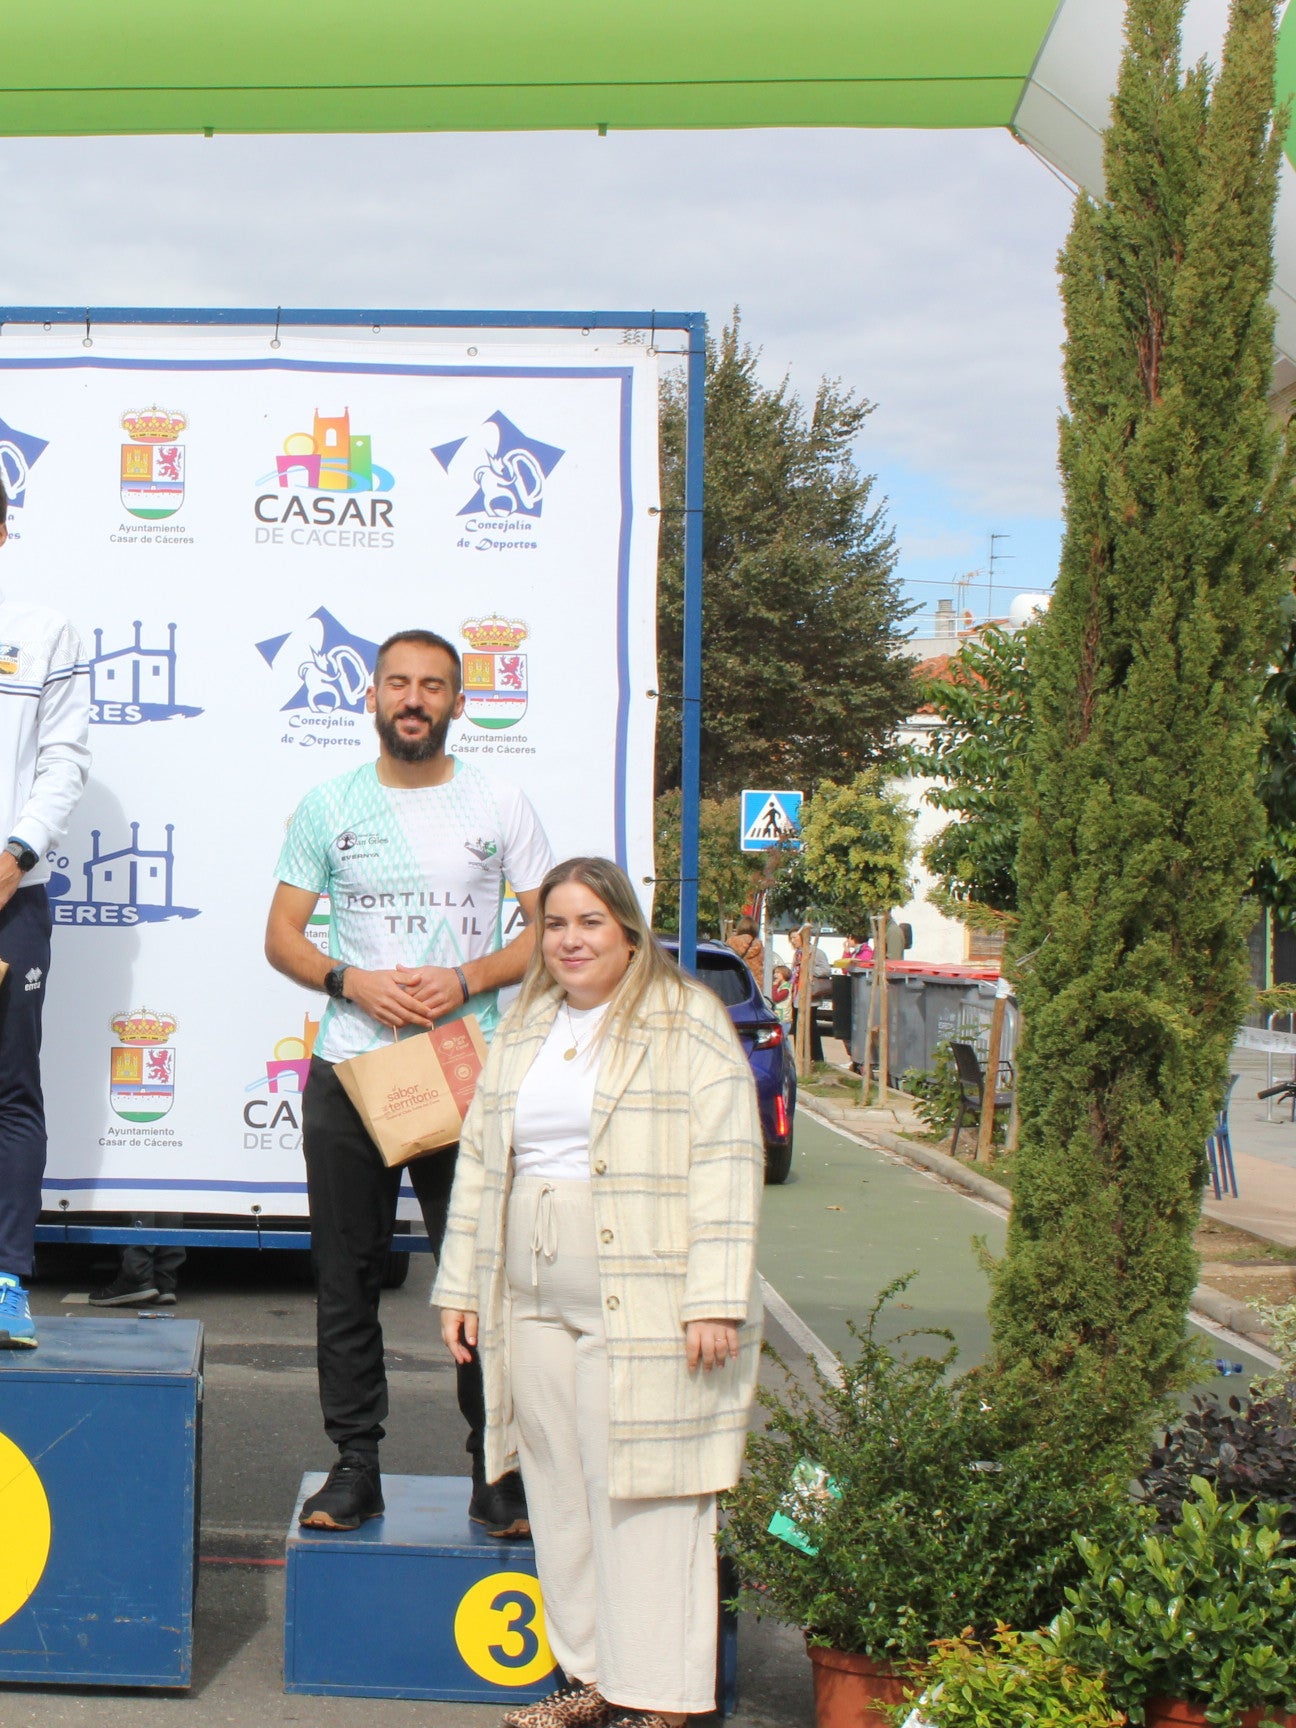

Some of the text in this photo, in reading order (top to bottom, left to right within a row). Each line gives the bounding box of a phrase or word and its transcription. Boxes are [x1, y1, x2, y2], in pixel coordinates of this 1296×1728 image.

[253, 494, 395, 528] CASAR
[118, 523, 186, 534] Ayuntamiento
[255, 527, 284, 544] DE
[109, 535, 194, 544] Casar de Cáceres
[456, 538, 538, 551] de Deportes
[280, 734, 361, 748] de Deportes
[459, 733, 528, 744] Ayuntamiento
[450, 744, 536, 755] Casar de Cáceres
[347, 891, 475, 909] PORTILLA
[54, 905, 140, 924] ERES
[386, 1083, 419, 1102] sabor
[388, 1088, 439, 1113] territorio
[107, 1126, 175, 1137] Ayuntamiento
[98, 1137, 183, 1148] Casar de Cáceres
[243, 1132, 272, 1150] DE
[486, 1590, 539, 1669] 3
